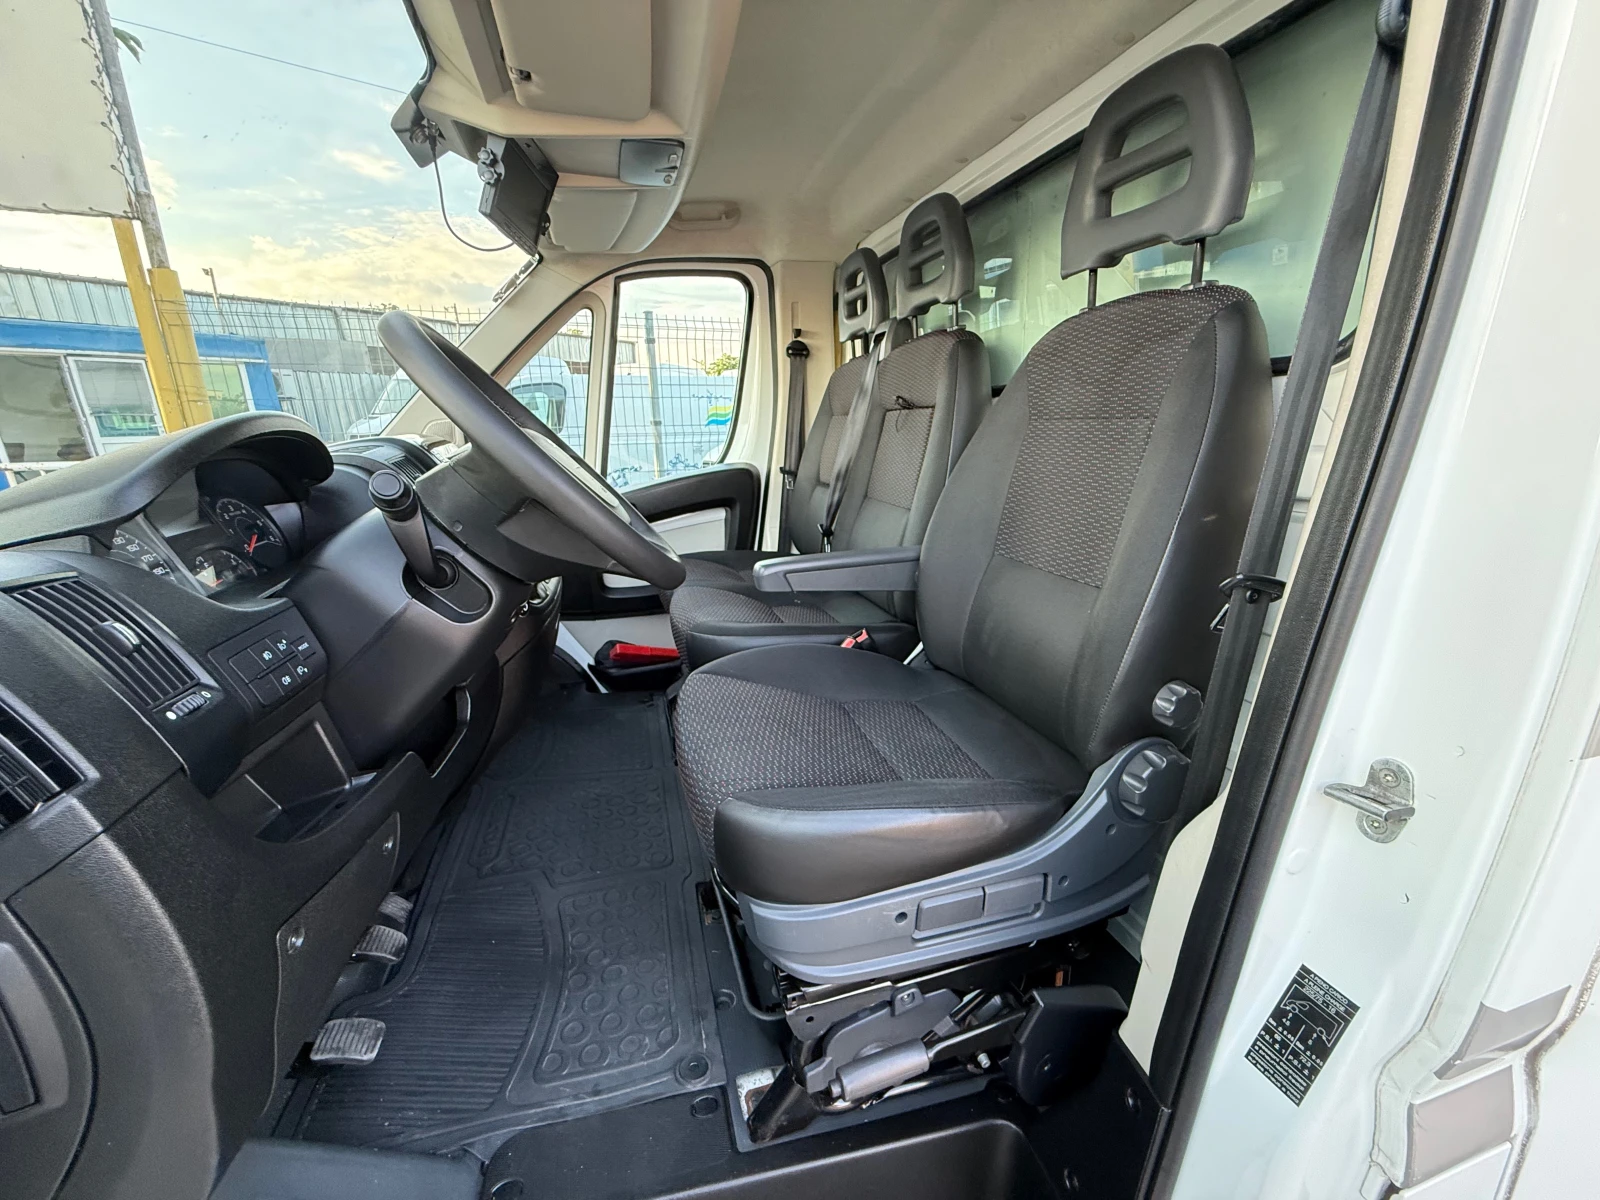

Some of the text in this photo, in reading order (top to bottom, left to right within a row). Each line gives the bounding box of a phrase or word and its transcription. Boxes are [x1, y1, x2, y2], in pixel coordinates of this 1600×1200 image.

[141, 554, 154, 562] 170
[1308, 980, 1325, 996] PLEINE
[1324, 993, 1345, 1012] CHARGE
[1313, 976, 1329, 989] PIENO
[1328, 987, 1348, 1004] CARICO
